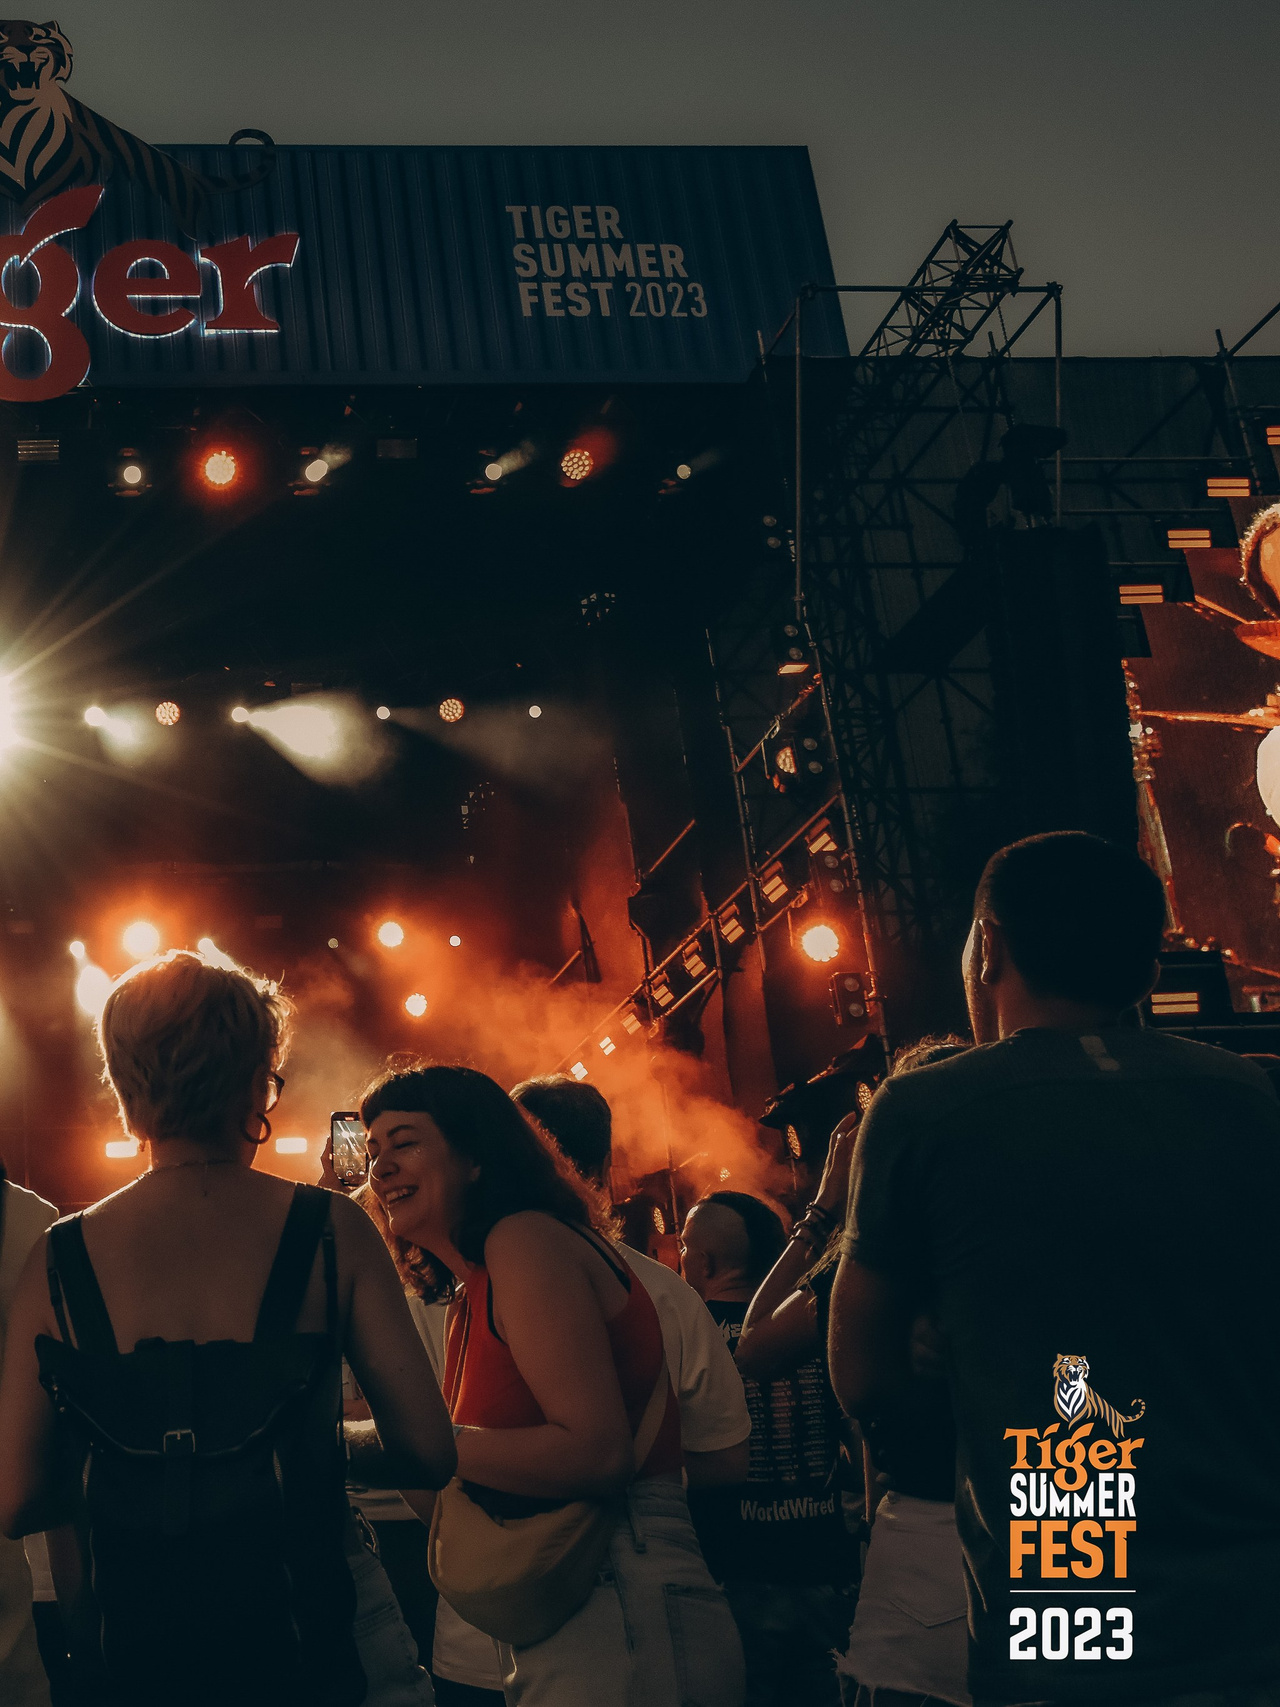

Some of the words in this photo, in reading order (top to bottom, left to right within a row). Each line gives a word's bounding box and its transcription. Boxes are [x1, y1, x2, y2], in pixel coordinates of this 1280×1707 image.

[505, 204, 624, 239] TIGER
[512, 243, 689, 278] SUMMER
[518, 281, 613, 317] FEST
[624, 282, 708, 318] 2023
[740, 1492, 835, 1522] WorldWired
